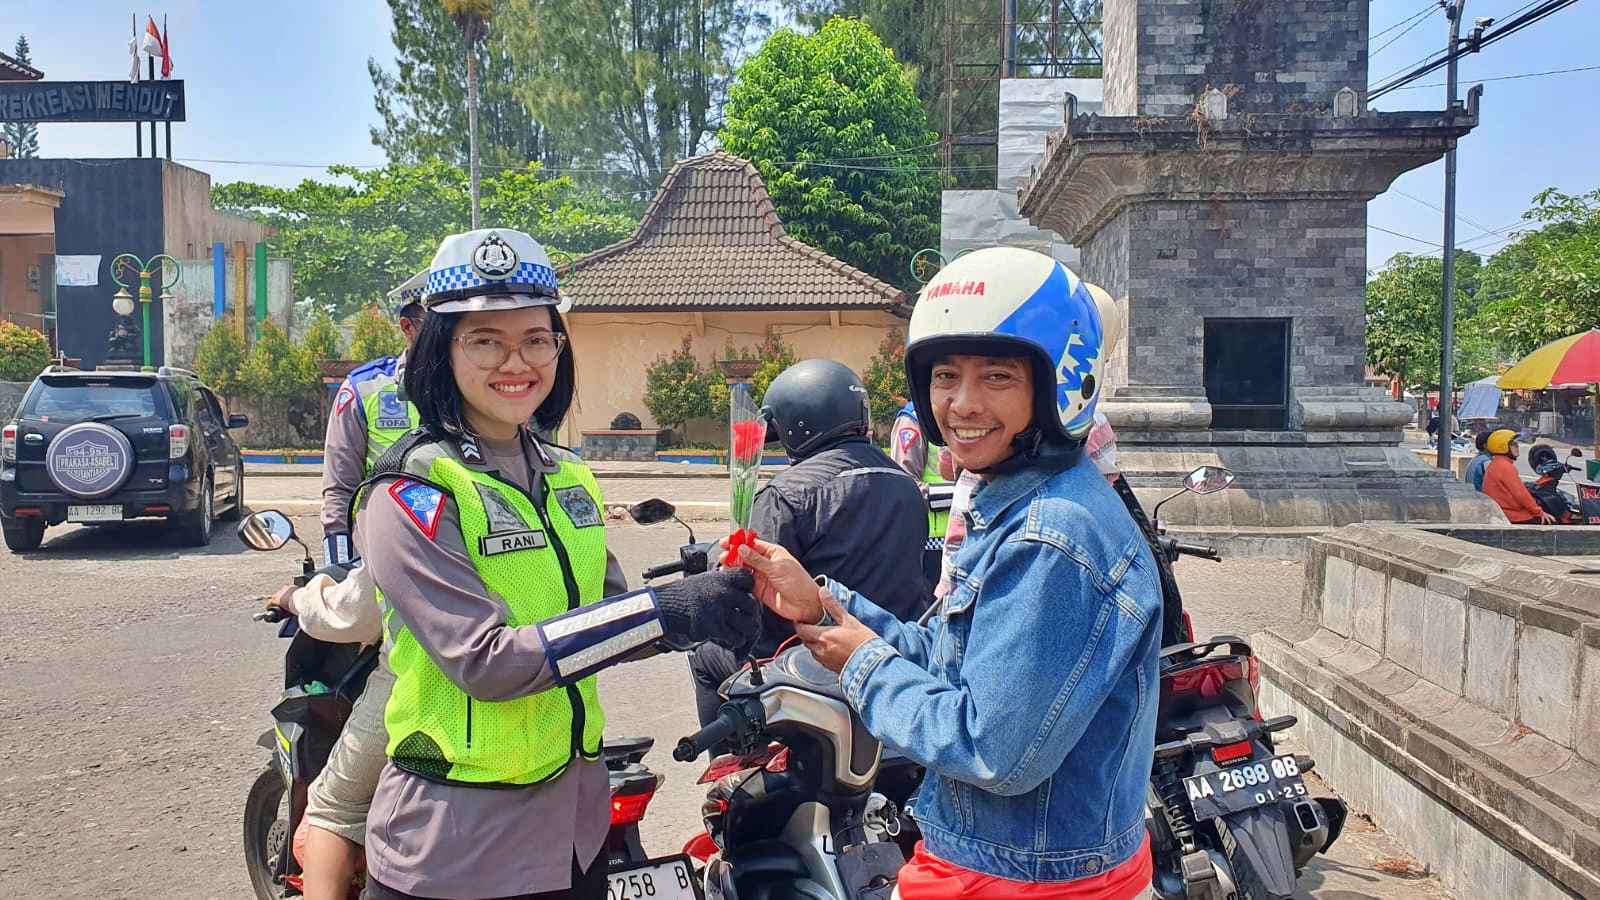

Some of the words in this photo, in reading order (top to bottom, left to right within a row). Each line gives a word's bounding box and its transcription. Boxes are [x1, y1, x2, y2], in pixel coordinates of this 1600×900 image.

[97, 83, 178, 118] MENDUT
[927, 281, 985, 301] YAMAHA
[379, 419, 407, 428] TOFA
[502, 536, 536, 551] RANI
[1221, 756, 1249, 766] HONDA
[1188, 776, 1215, 801] AA
[1219, 763, 1270, 792] 2698
